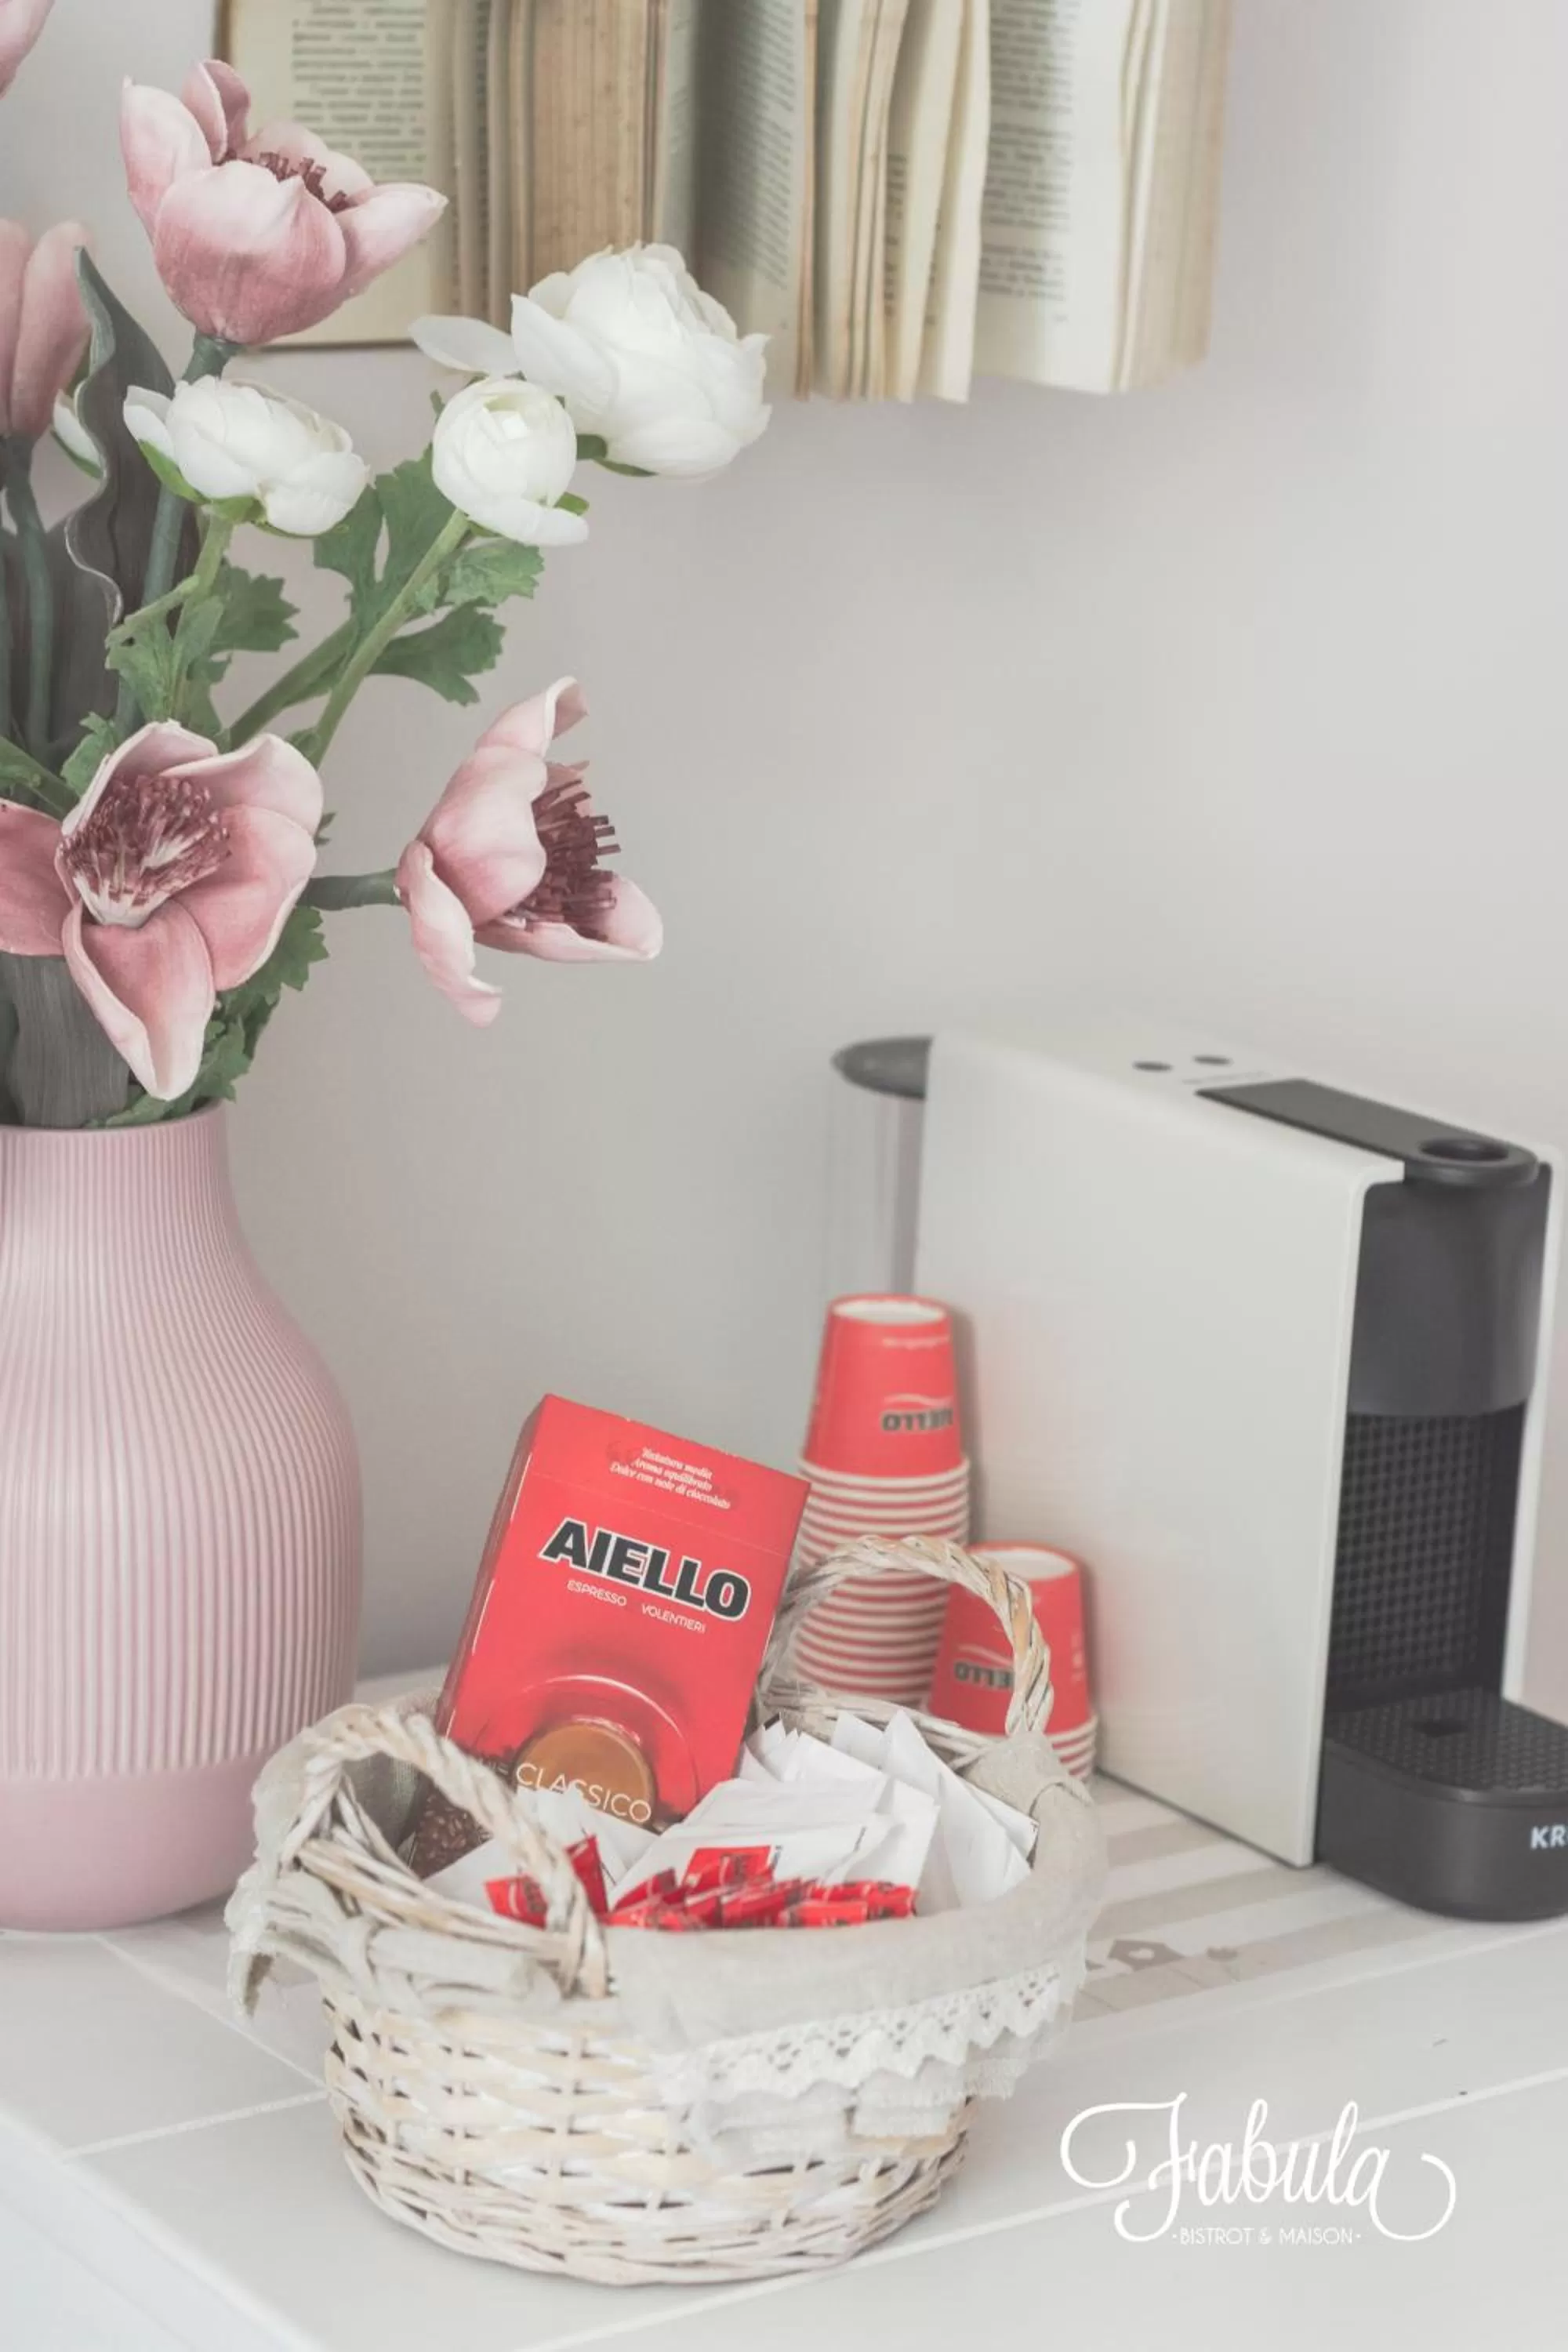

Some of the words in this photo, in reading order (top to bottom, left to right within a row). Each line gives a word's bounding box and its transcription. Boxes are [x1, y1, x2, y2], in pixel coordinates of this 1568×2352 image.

[536, 1516, 752, 1622] AIELLO
[567, 1580, 627, 1606] ESPRESSO
[641, 1602, 706, 1634] VOLENTIERI
[1530, 1824, 1568, 1850] KR
